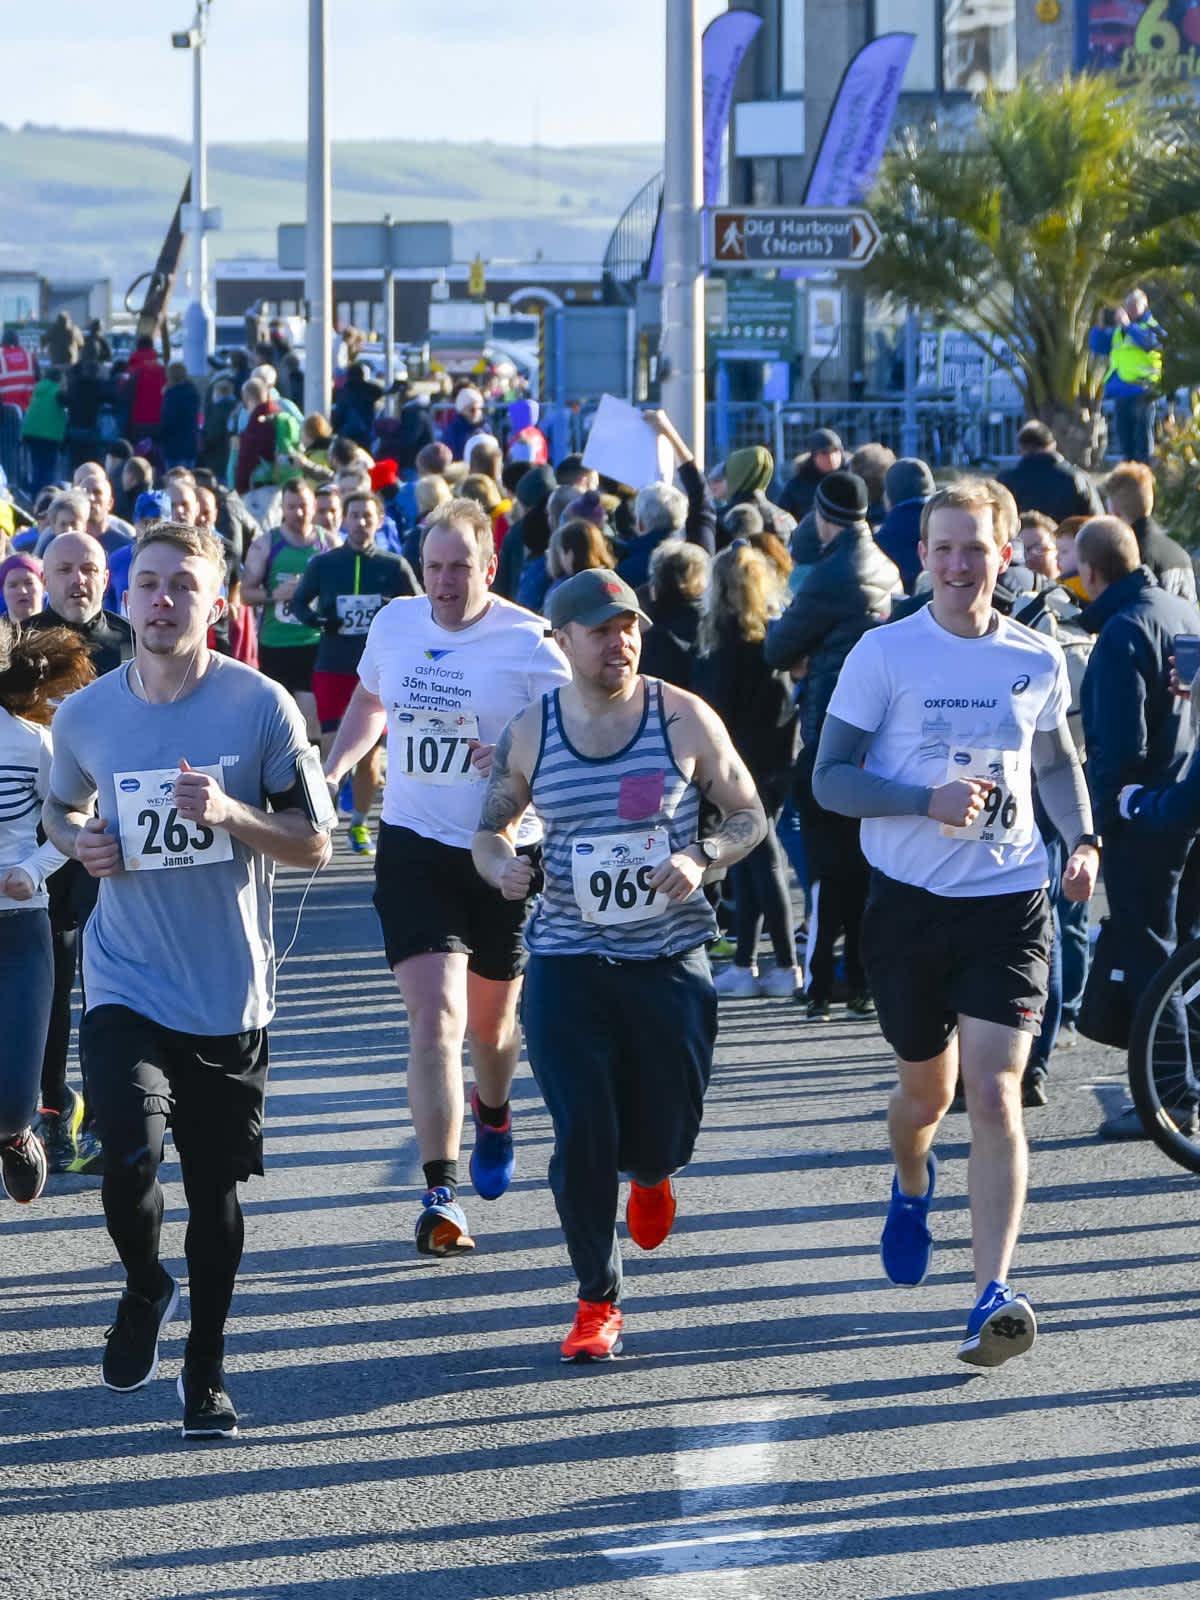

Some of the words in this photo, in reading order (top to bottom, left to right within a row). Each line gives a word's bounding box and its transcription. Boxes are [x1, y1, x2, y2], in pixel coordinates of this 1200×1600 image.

[744, 219, 775, 234] Old
[781, 219, 851, 234] Harbour
[761, 237, 833, 255] (North)
[415, 665, 465, 681] ashfords
[402, 676, 428, 690] 35th
[431, 682, 472, 698] Taunton
[409, 692, 462, 709] Marathon
[924, 699, 969, 709] OXFORD
[971, 699, 999, 709] HALF
[407, 736, 479, 774] 1077
[146, 797, 175, 808] WEYM
[983, 786, 1018, 830] 96
[137, 805, 215, 855] 263
[162, 855, 195, 868] James
[589, 865, 657, 912] 969
